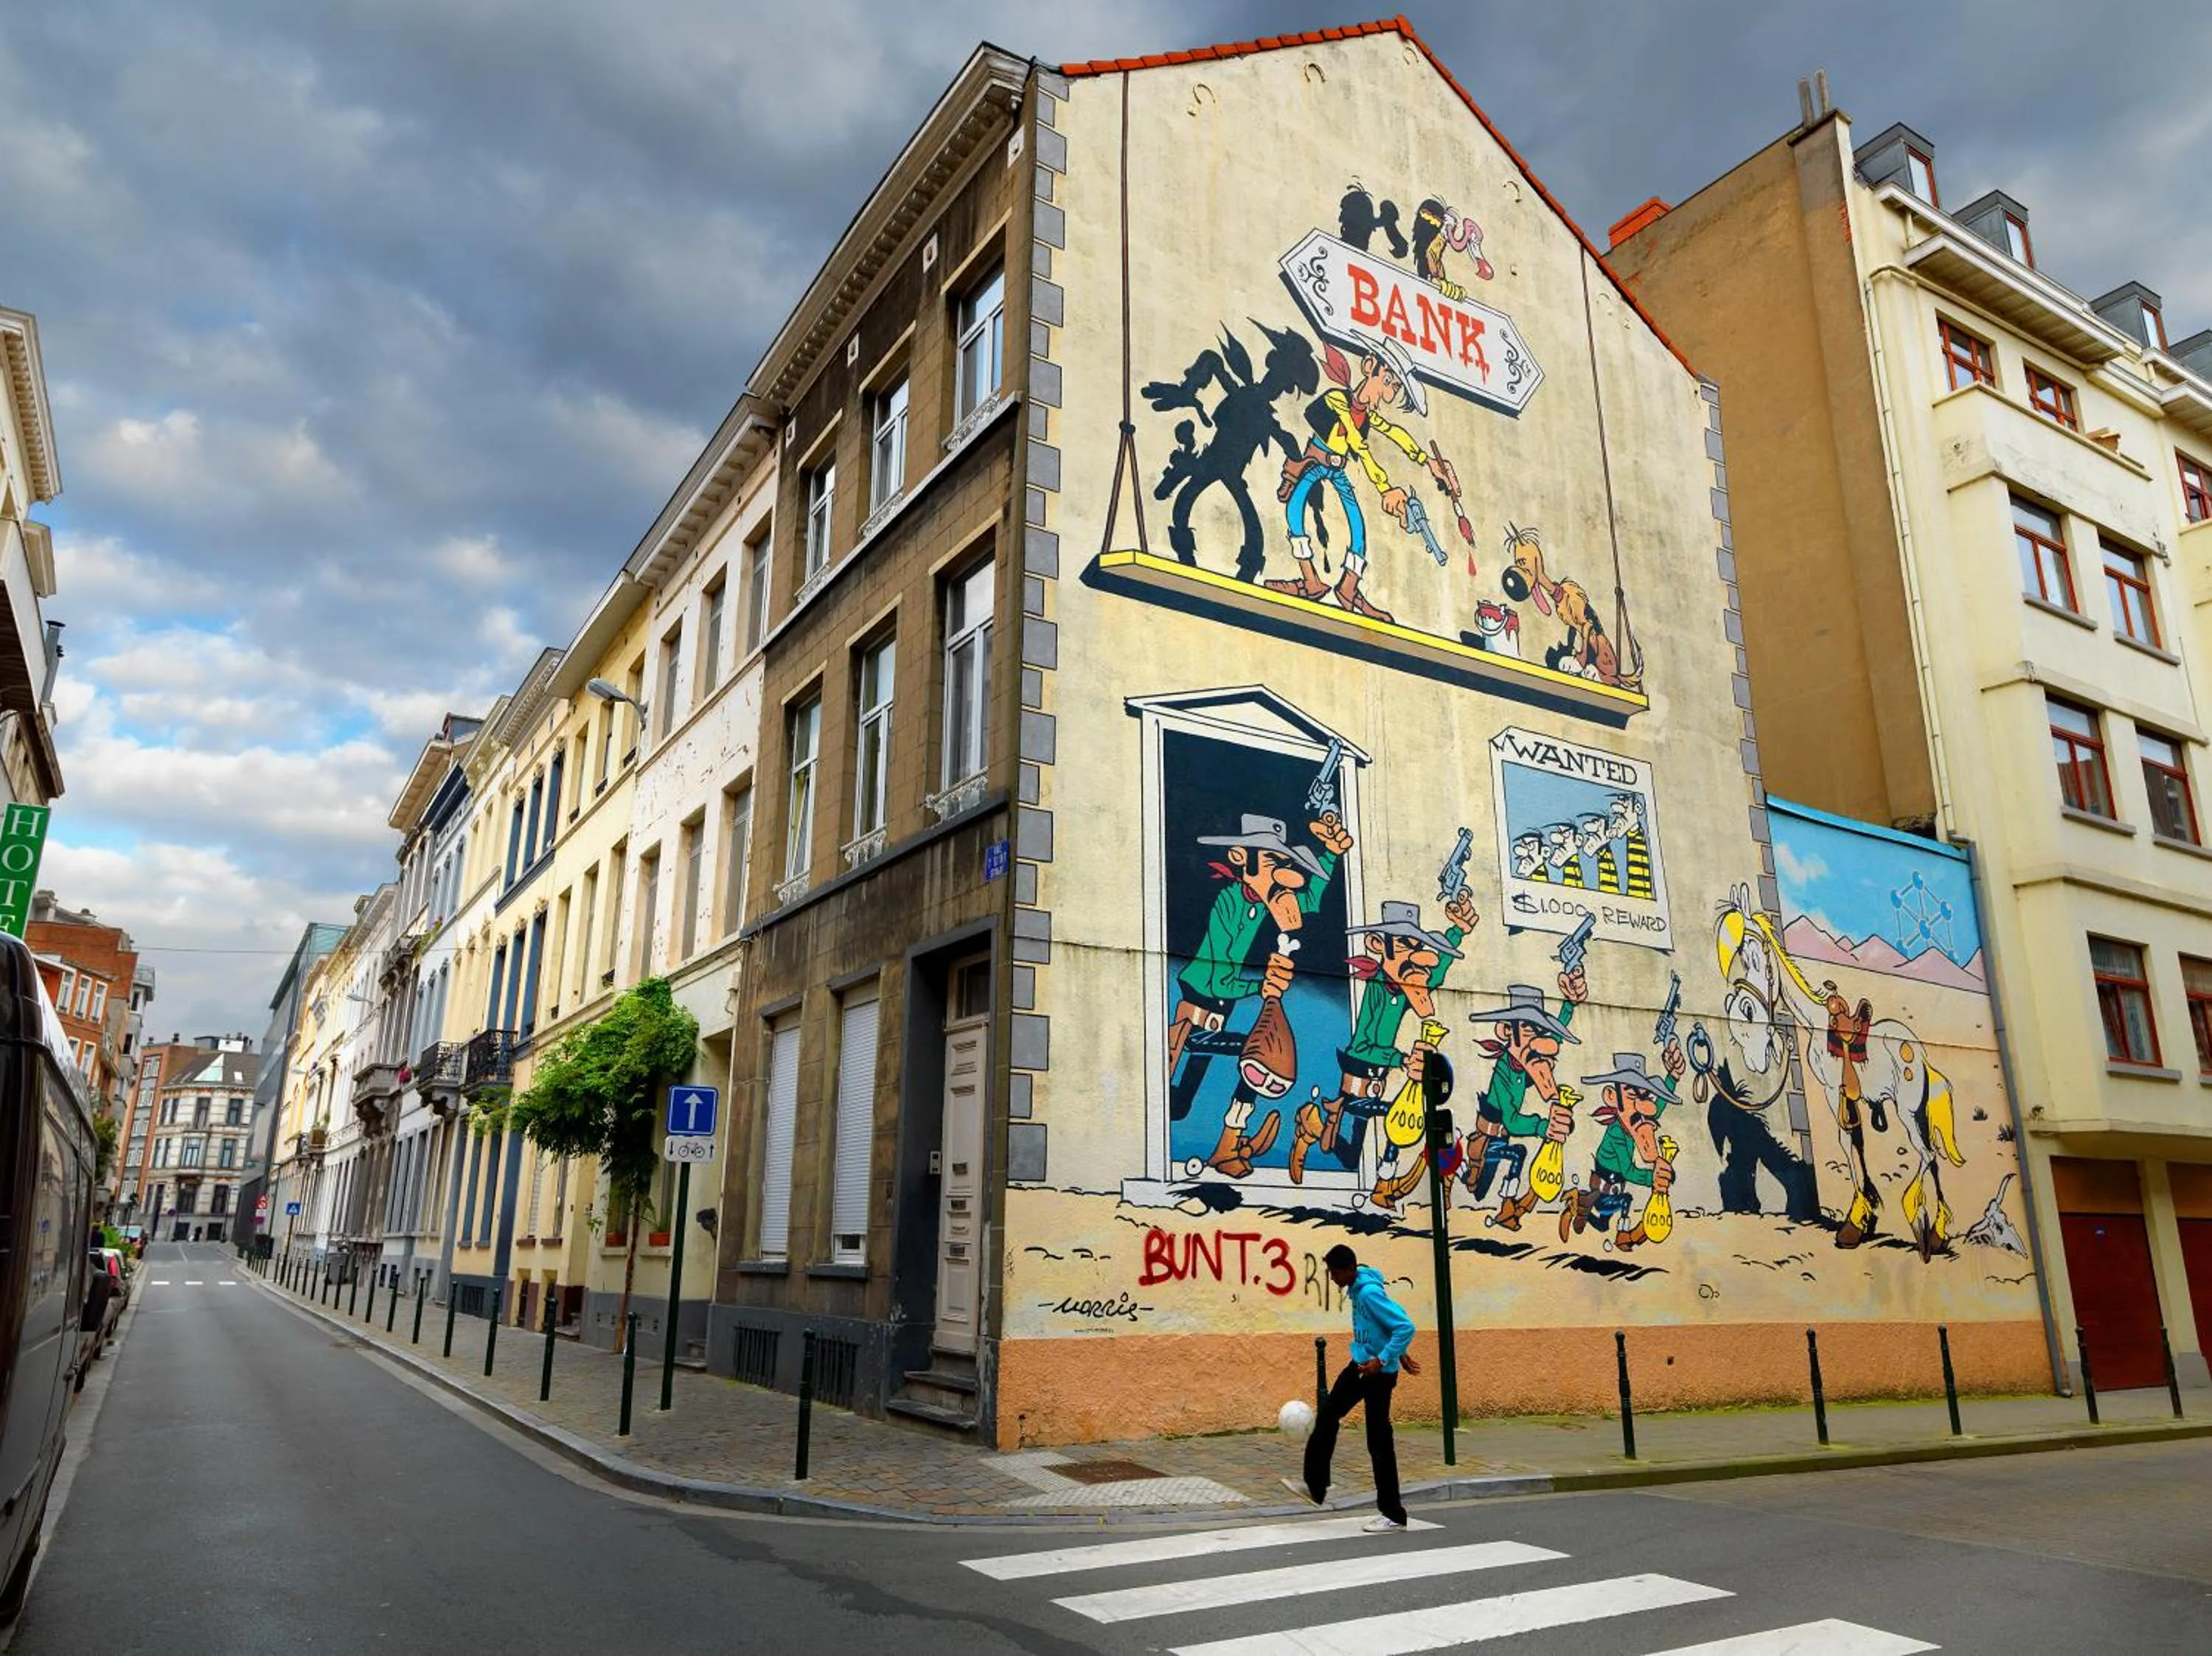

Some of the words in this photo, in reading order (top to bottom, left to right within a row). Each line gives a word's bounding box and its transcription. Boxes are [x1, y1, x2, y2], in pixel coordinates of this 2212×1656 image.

[1348, 262, 1490, 383] BANK
[1506, 734, 1638, 785] WANTED
[1601, 906, 1667, 932] REWARD
[1391, 1110, 1424, 1130] 1000
[1536, 1166, 1562, 1185] 1000
